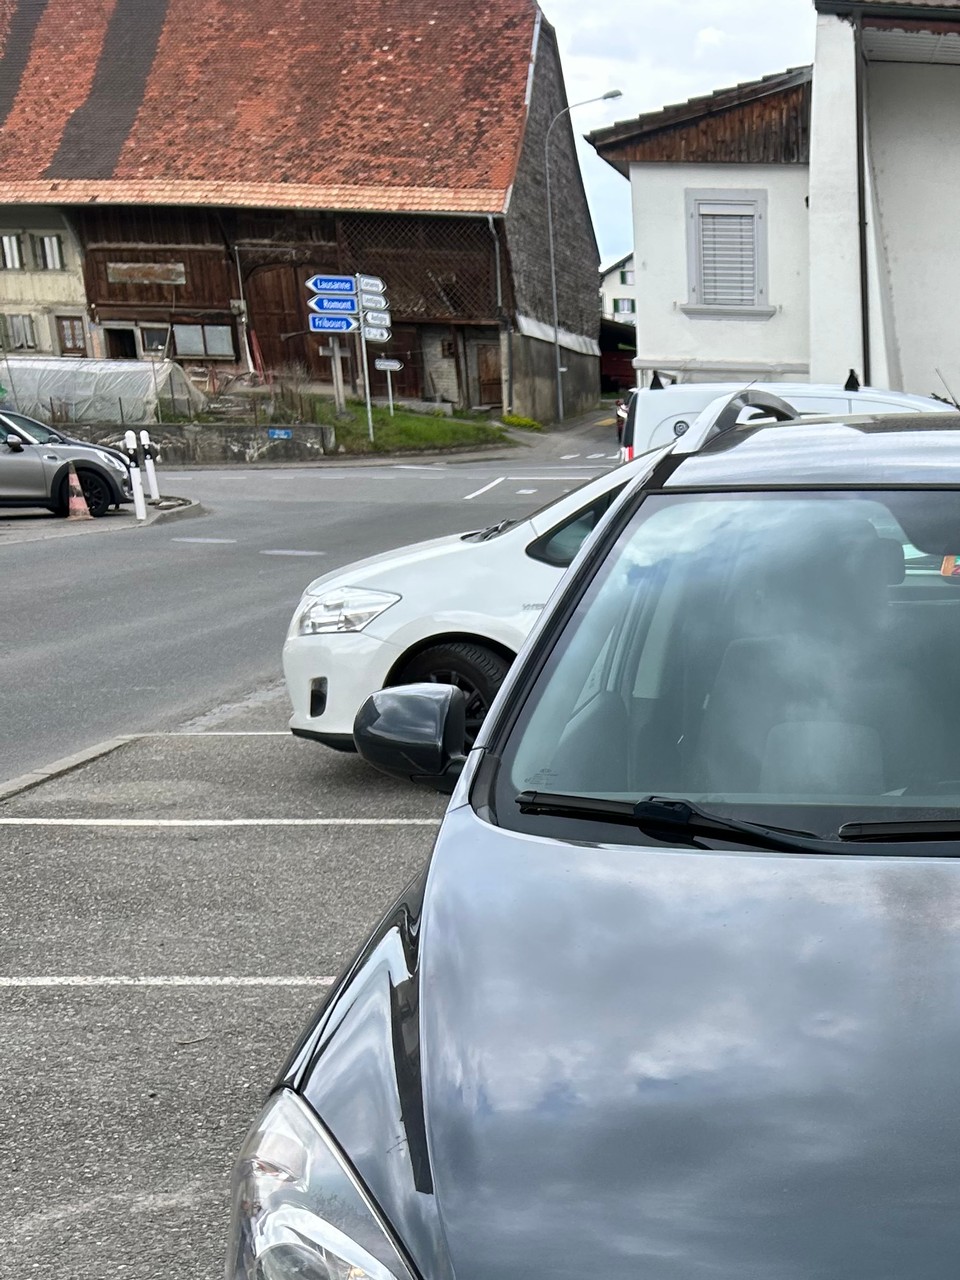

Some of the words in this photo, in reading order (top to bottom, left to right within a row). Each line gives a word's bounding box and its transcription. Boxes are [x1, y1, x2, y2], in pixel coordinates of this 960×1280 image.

[317, 279, 351, 290] Lausanne
[323, 299, 352, 310] Romont
[315, 317, 347, 330] Fribourg
